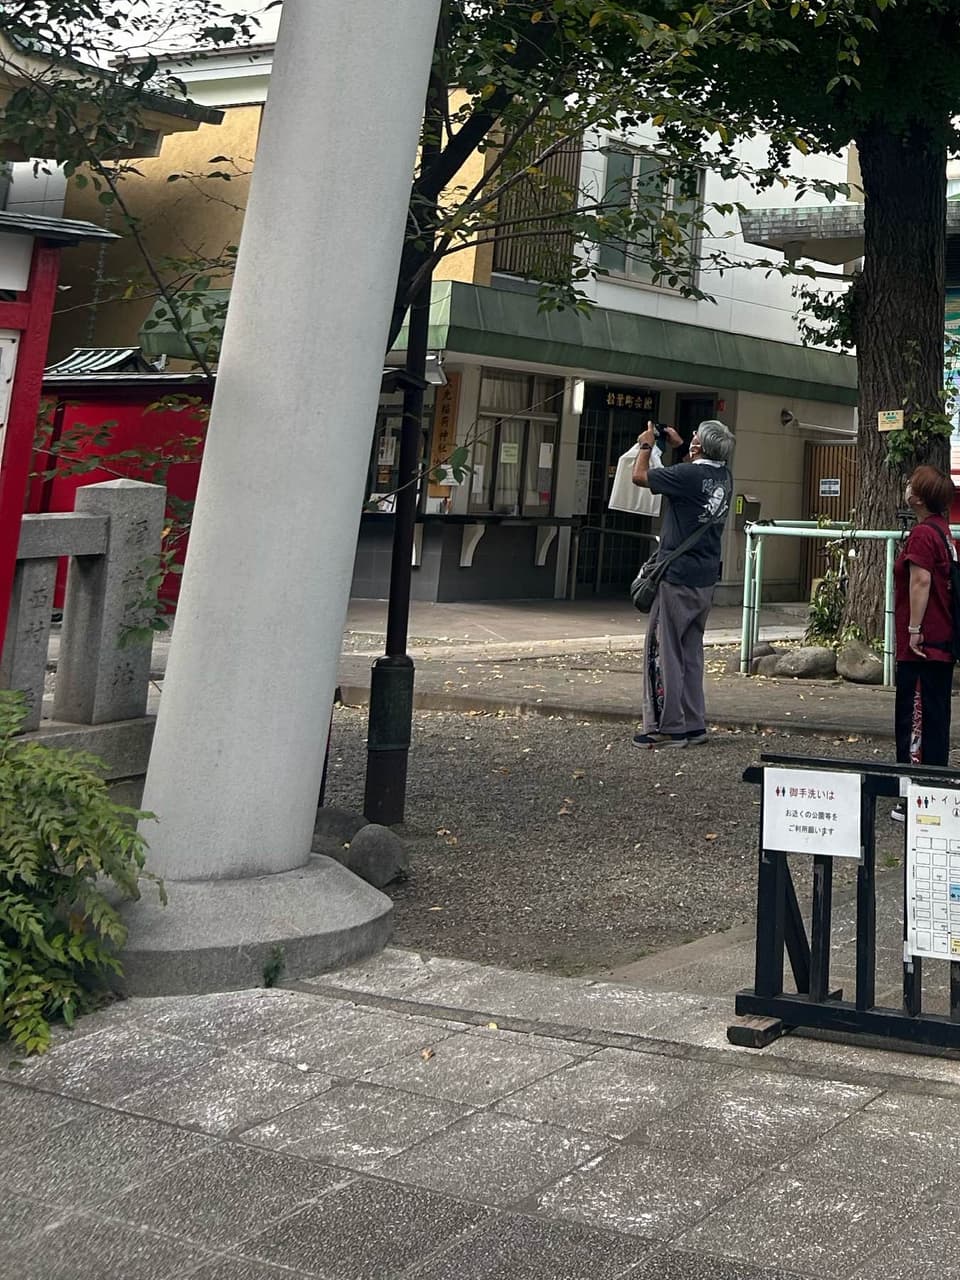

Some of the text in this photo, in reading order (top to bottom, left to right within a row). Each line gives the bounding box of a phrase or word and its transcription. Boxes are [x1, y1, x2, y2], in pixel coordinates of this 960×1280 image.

[789, 787, 836, 801] 御手洗いは
